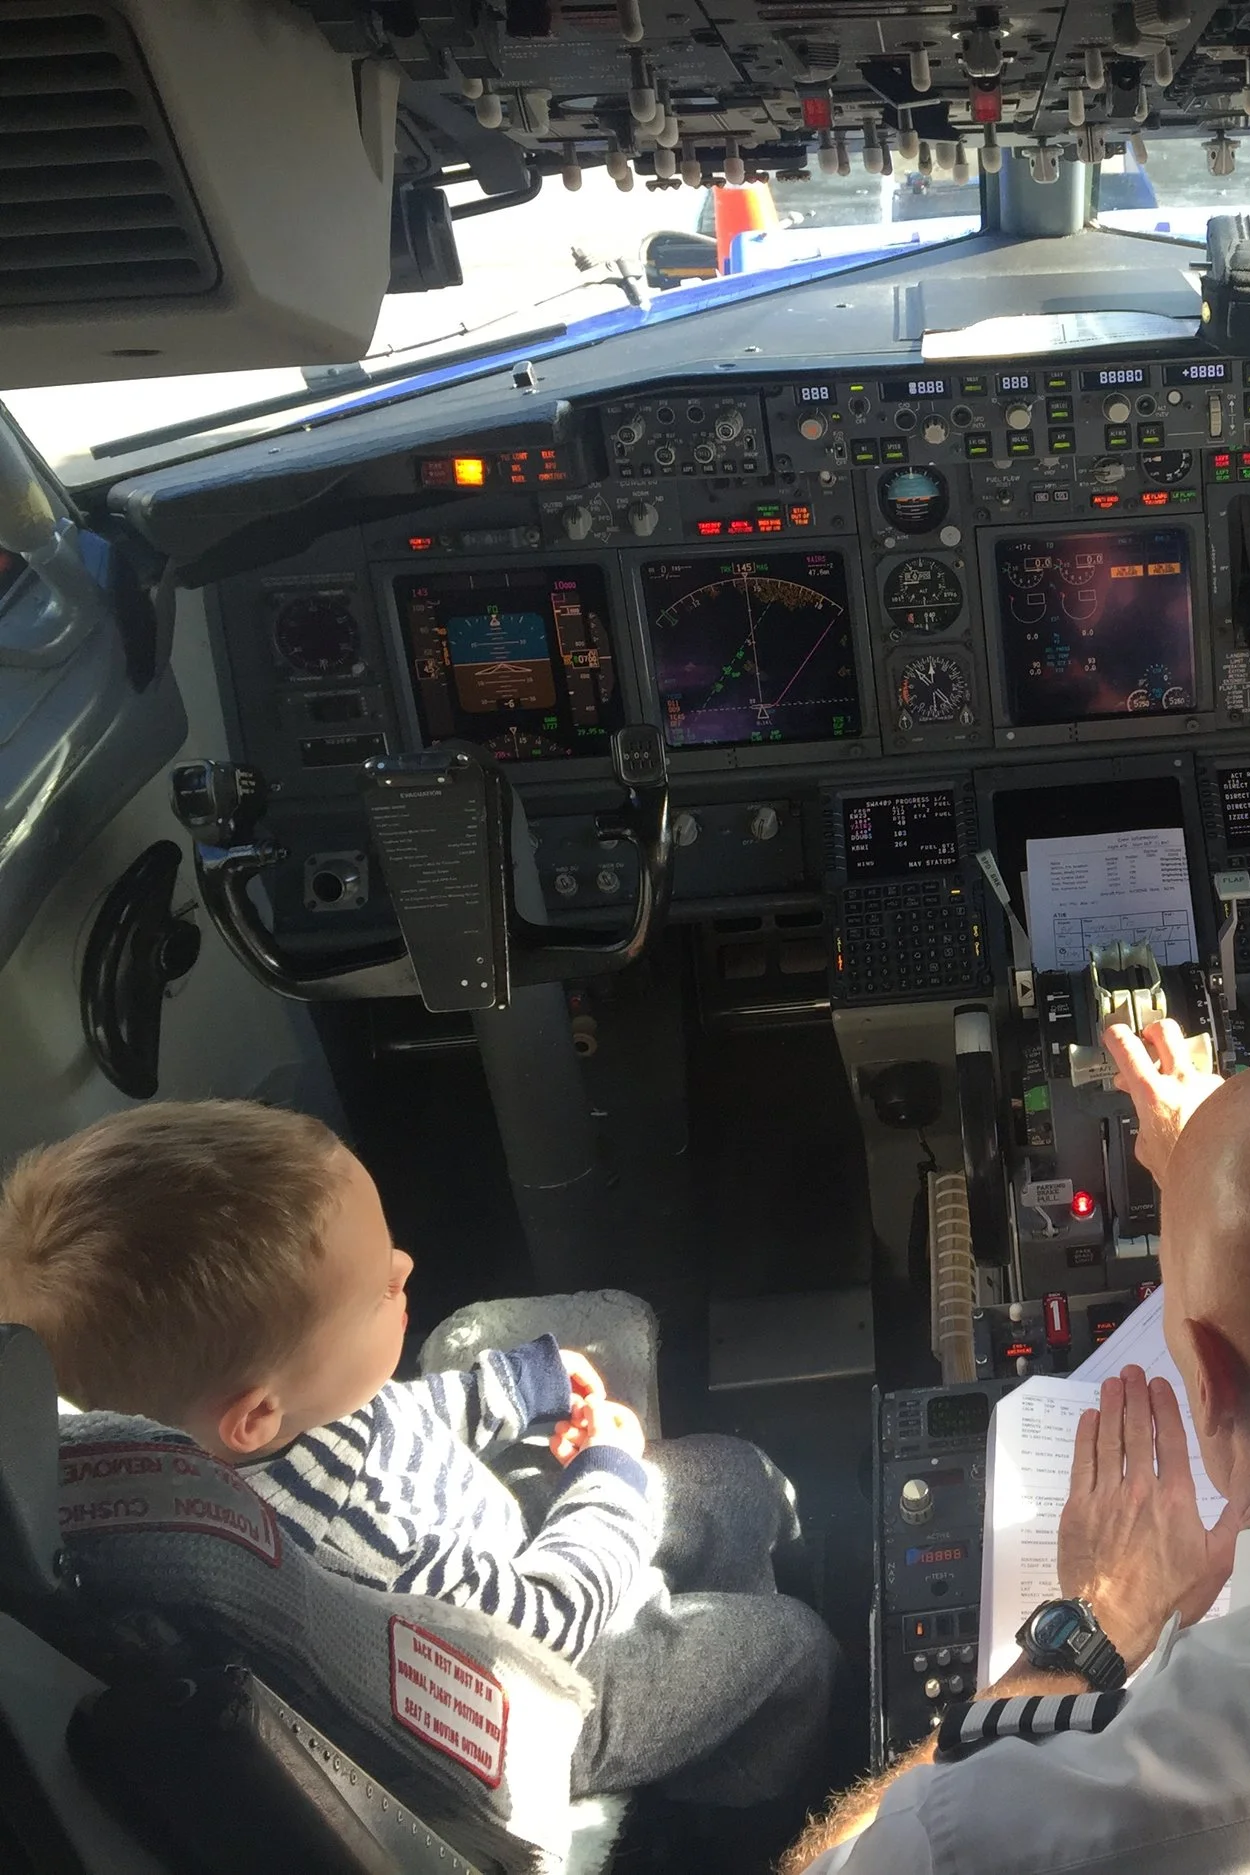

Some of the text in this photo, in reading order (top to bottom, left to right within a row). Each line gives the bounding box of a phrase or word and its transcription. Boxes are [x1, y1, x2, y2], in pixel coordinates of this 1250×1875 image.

[735, 562, 752, 572] 145
[895, 796, 930, 805] PROGRESS
[1224, 792, 1250, 800] DIRECT
[1222, 876, 1245, 884] FLAP
[1196, 1000, 1203, 1008] 2
[1199, 1017, 1207, 1025] 5
[174, 1497, 260, 1541] FLOTATION
[412, 1637, 493, 1703] BACK REST MUST BE IN
[397, 1659, 428, 1693] NORMAL
[429, 1679, 452, 1709] FLIGHT
[453, 1697, 484, 1730] POSITION
[405, 1697, 493, 1770] SEAT IS MOVING OUTBOARD
